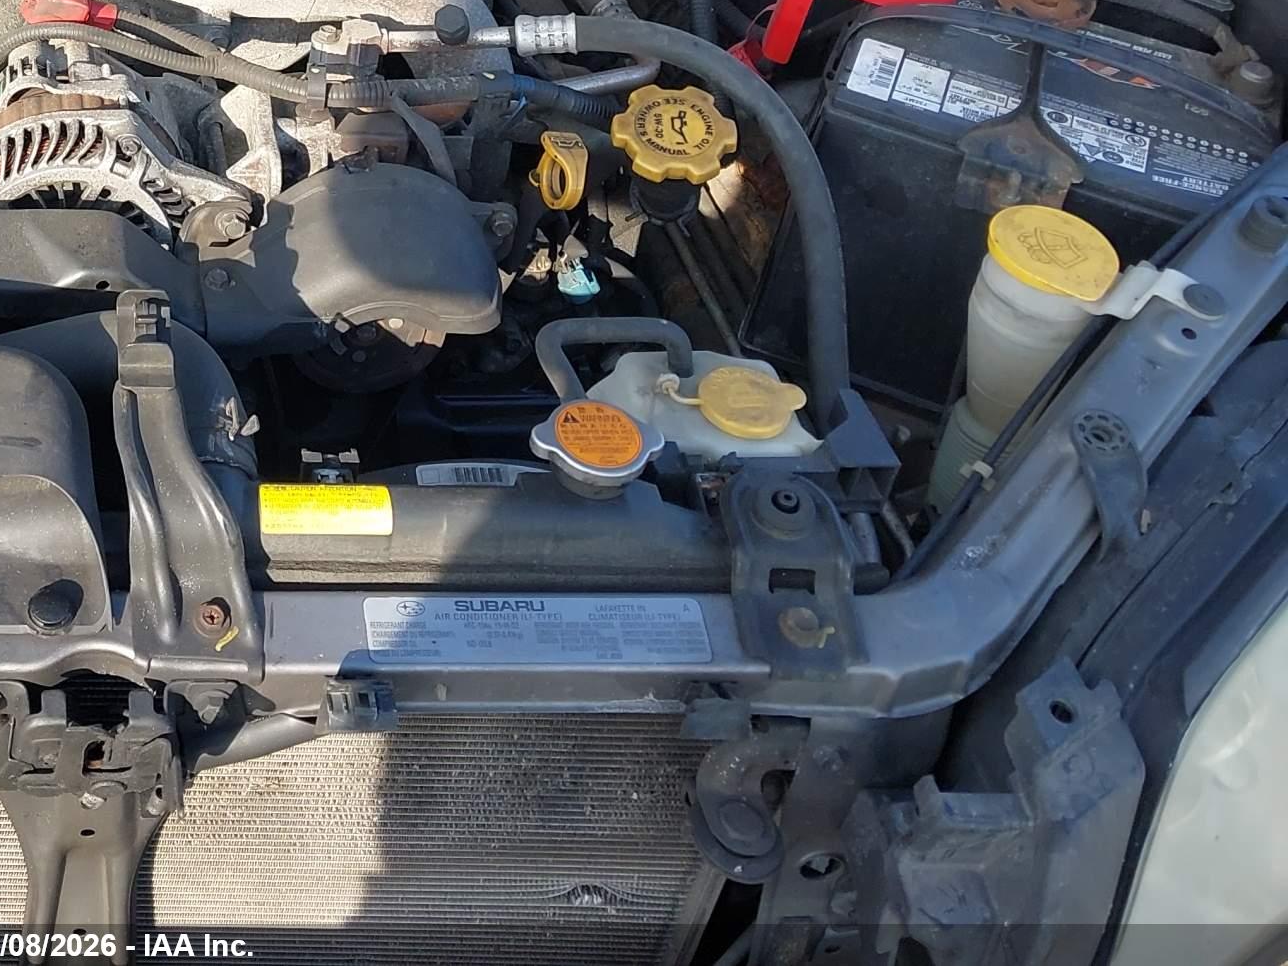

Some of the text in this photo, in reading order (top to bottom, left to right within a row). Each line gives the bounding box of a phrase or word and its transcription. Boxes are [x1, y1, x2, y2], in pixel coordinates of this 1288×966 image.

[690, 103, 714, 150] ENGINE OIL
[645, 137, 691, 156] MANUAL
[454, 600, 545, 612] SUBARU
[434, 612, 452, 621] AIR
[453, 612, 519, 621] CONDITIONER
